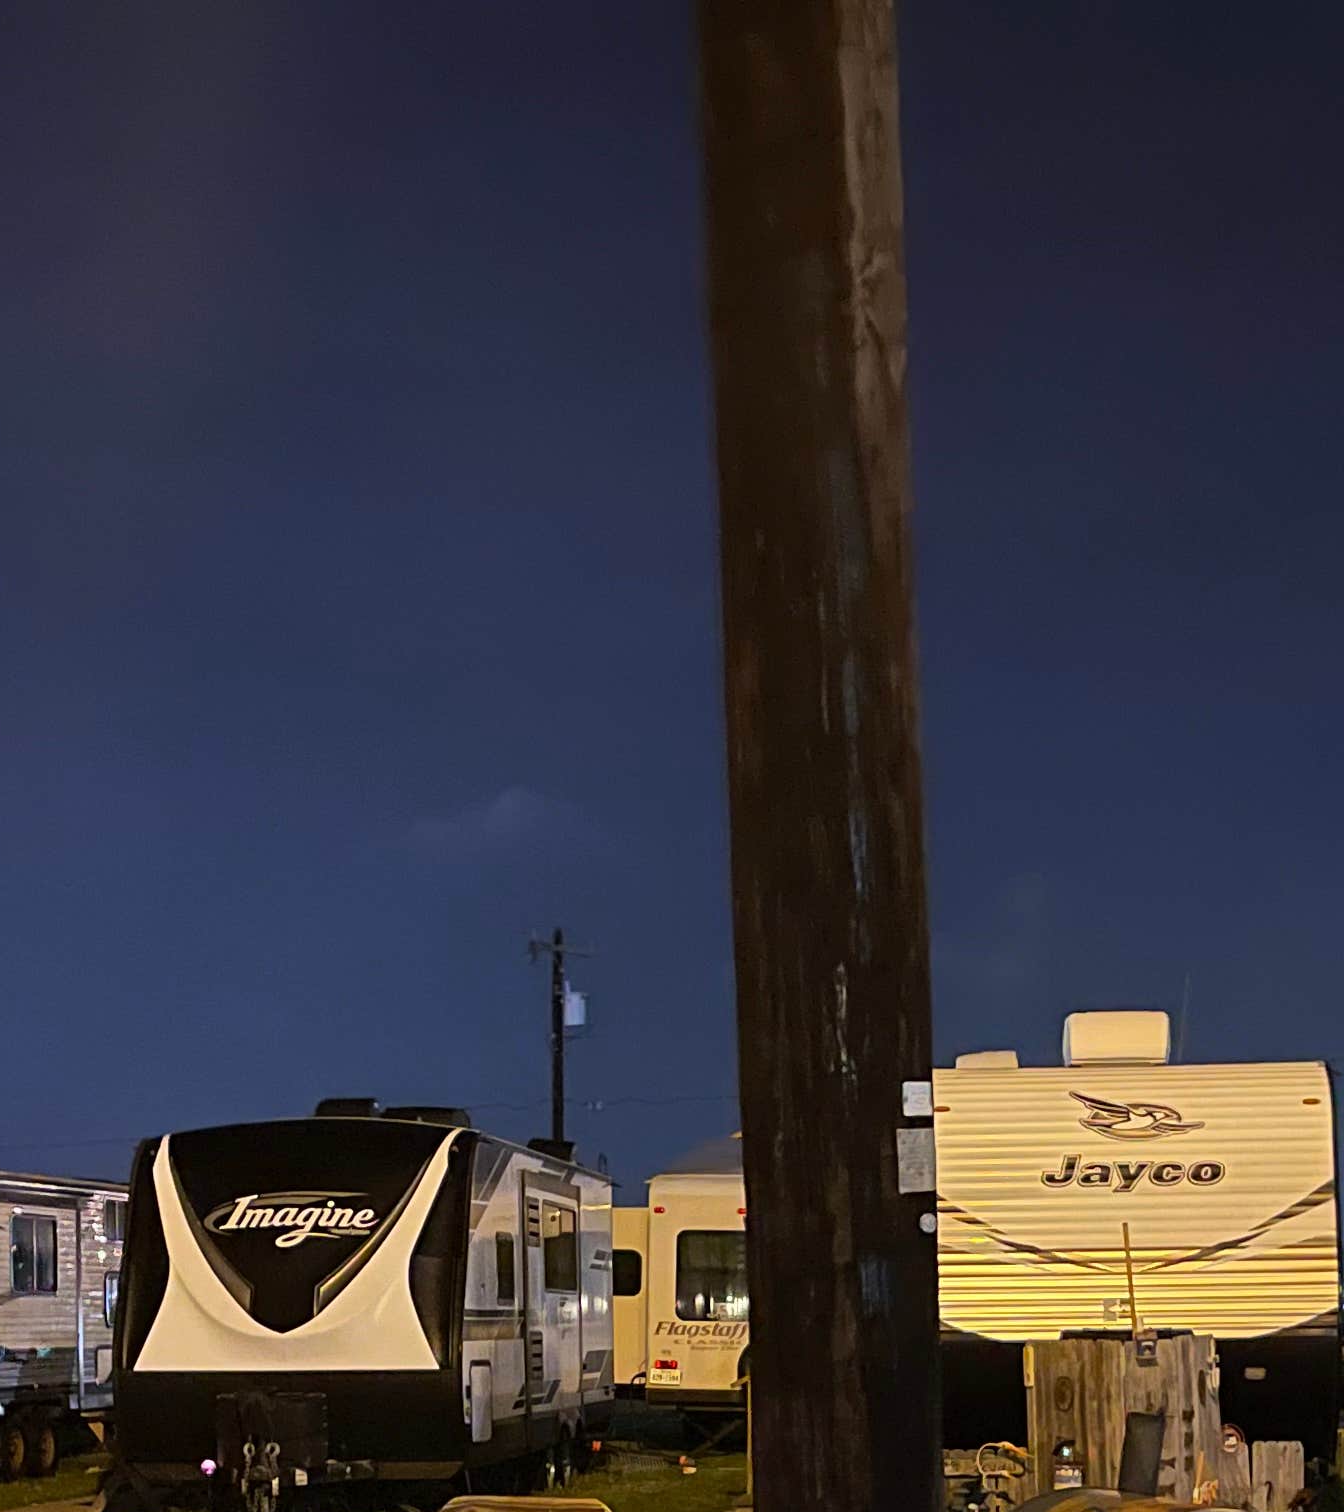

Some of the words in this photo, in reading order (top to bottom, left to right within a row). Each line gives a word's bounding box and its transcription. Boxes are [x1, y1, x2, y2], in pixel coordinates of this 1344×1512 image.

[1041, 1154, 1226, 1192] Jayco
[219, 1194, 380, 1248] Imagine
[654, 1321, 747, 1339] Flagstaff
